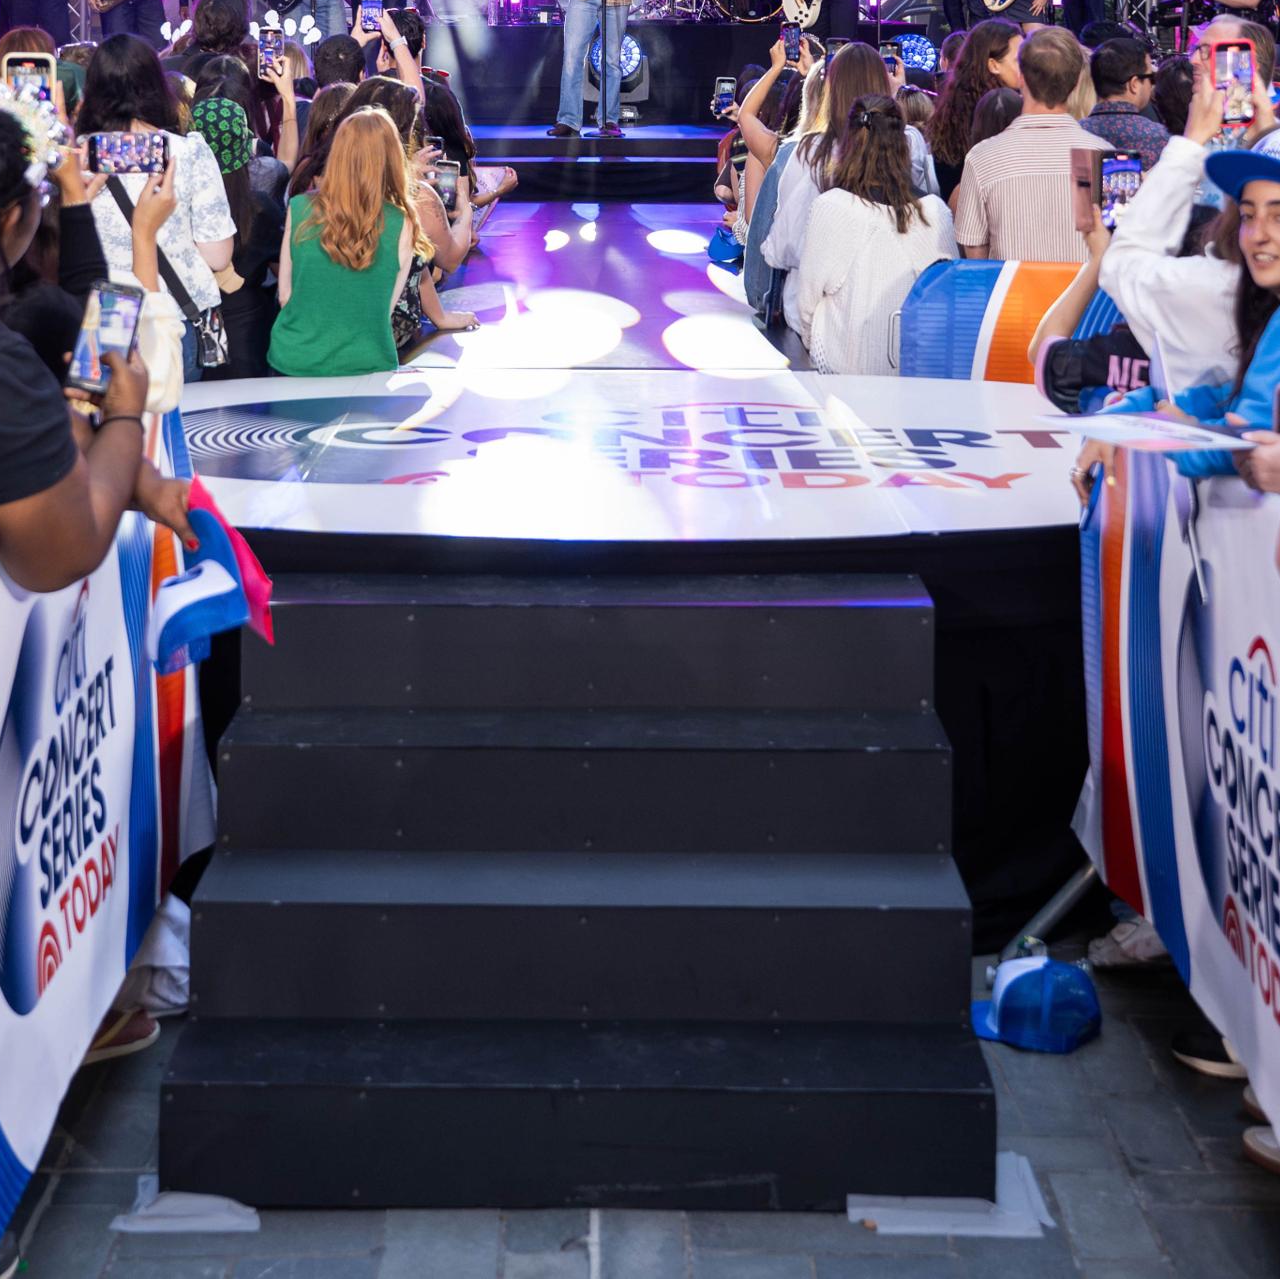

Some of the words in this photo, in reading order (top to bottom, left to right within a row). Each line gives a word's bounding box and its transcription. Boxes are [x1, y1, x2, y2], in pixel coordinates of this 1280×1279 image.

[54, 616, 88, 716] citi
[1228, 657, 1277, 769] citi
[19, 656, 117, 845] CONCERT
[40, 765, 106, 909] SERIES
[60, 824, 121, 950] TODAY
